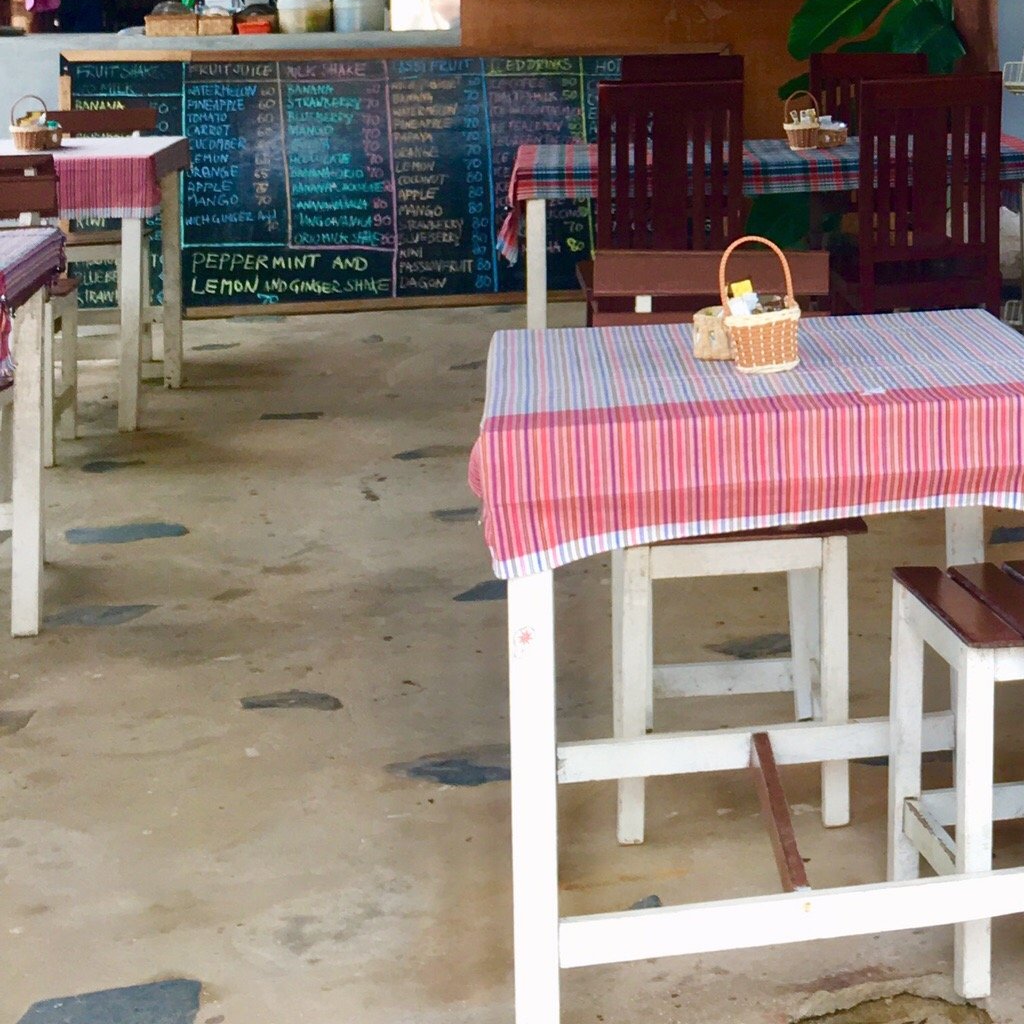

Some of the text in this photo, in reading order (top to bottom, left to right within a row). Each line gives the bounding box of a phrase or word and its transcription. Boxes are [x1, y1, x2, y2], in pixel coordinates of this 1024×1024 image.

[188, 63, 273, 76] FRUIT JUICE
[75, 99, 127, 111] BANANA
[187, 165, 240, 178] ORANGE
[187, 180, 233, 193] APPLE
[187, 193, 239, 207] MANGO
[398, 187, 440, 201] APPLE
[398, 204, 443, 217] MANGO
[192, 252, 368, 273] PEPPERMINT AND
[191, 275, 260, 295] LEMON
[265, 279, 288, 293] AND
[289, 279, 344, 294] GINGER
